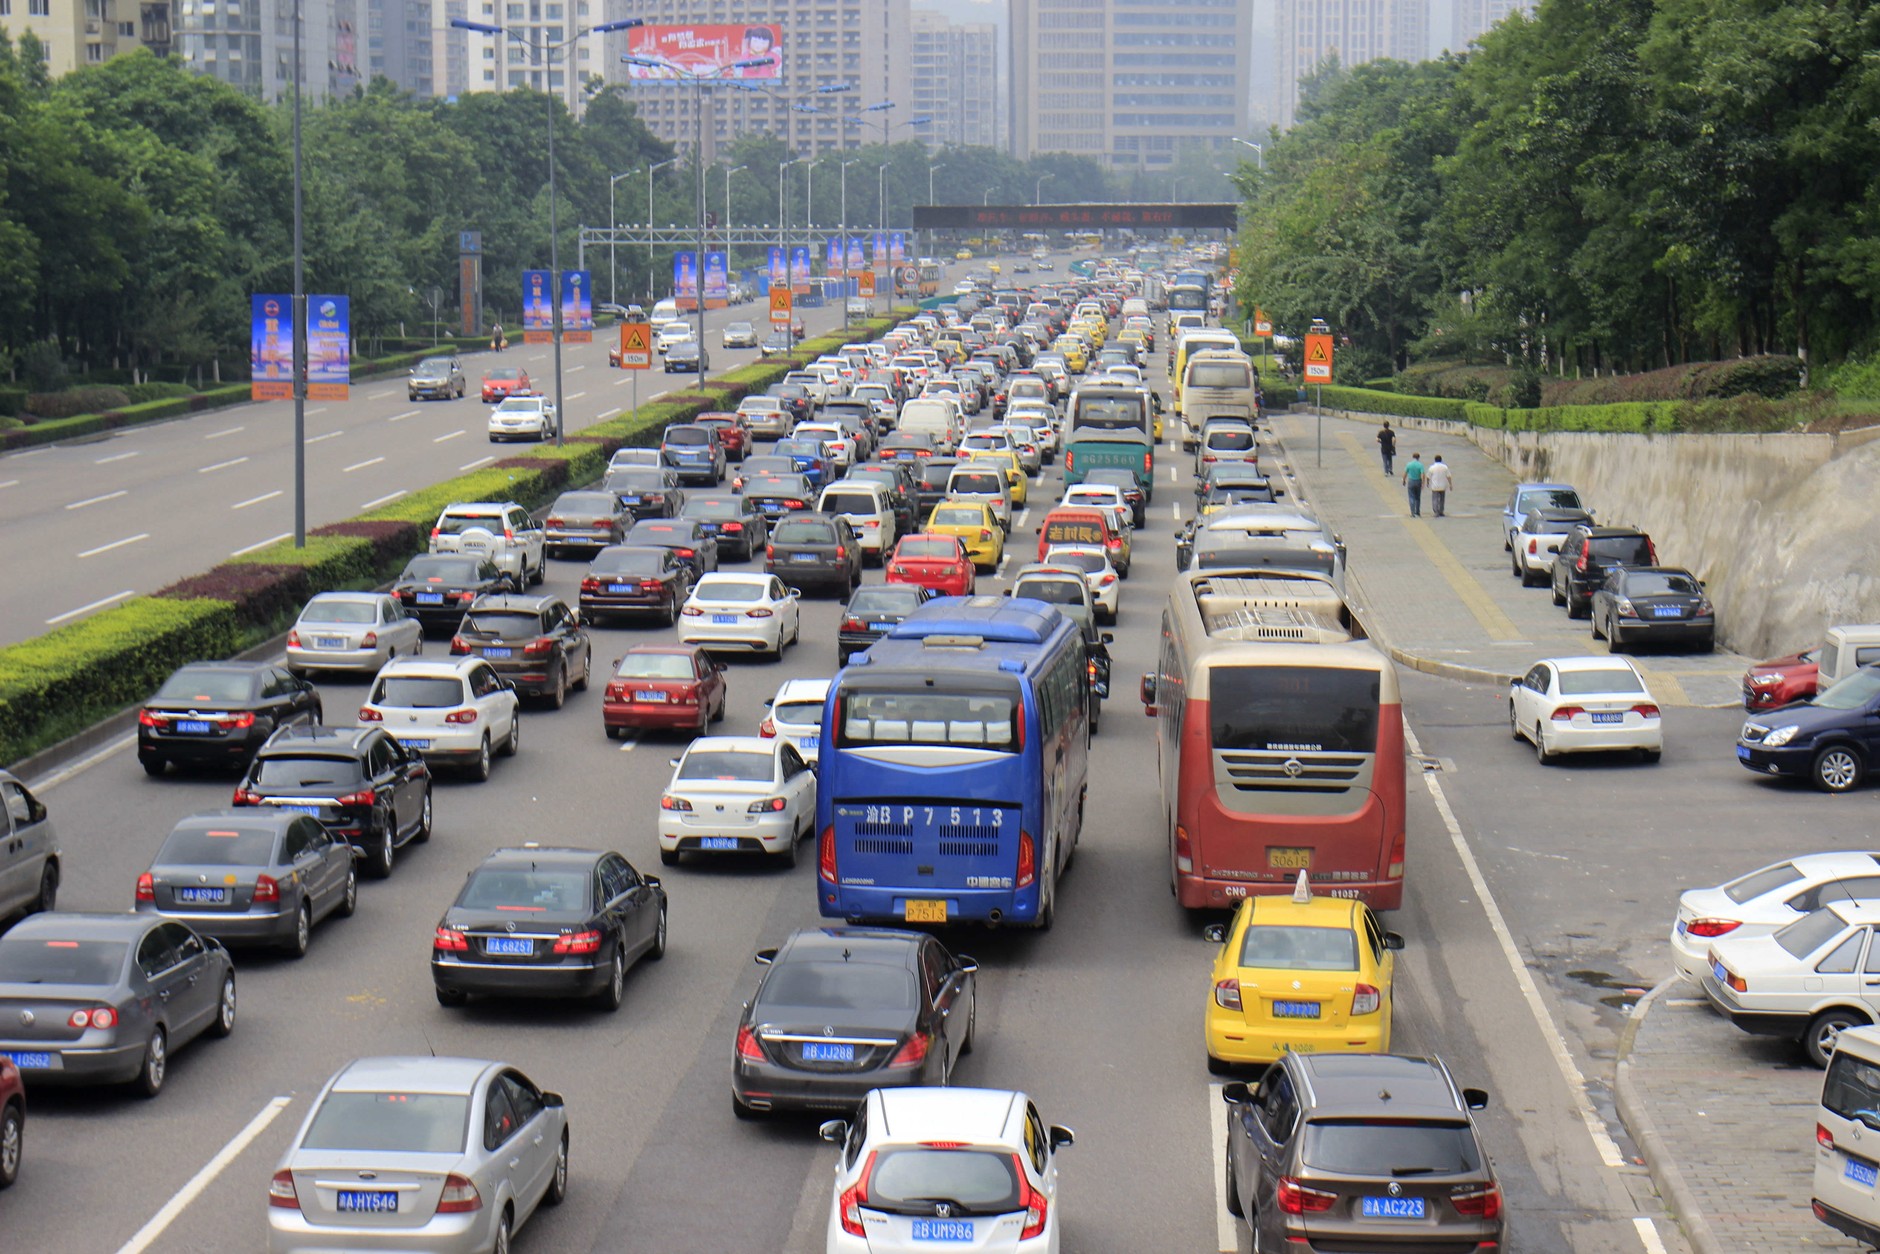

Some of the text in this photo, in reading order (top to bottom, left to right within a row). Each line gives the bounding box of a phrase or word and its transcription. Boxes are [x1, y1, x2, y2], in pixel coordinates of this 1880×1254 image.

[461, 233, 472, 248] P
[628, 354, 644, 362] 150m
[1311, 366, 1326, 375] 150m
[1272, 855, 1308, 867] 30615
[1225, 886, 1247, 896] CNG
[907, 908, 945, 920] P7513
